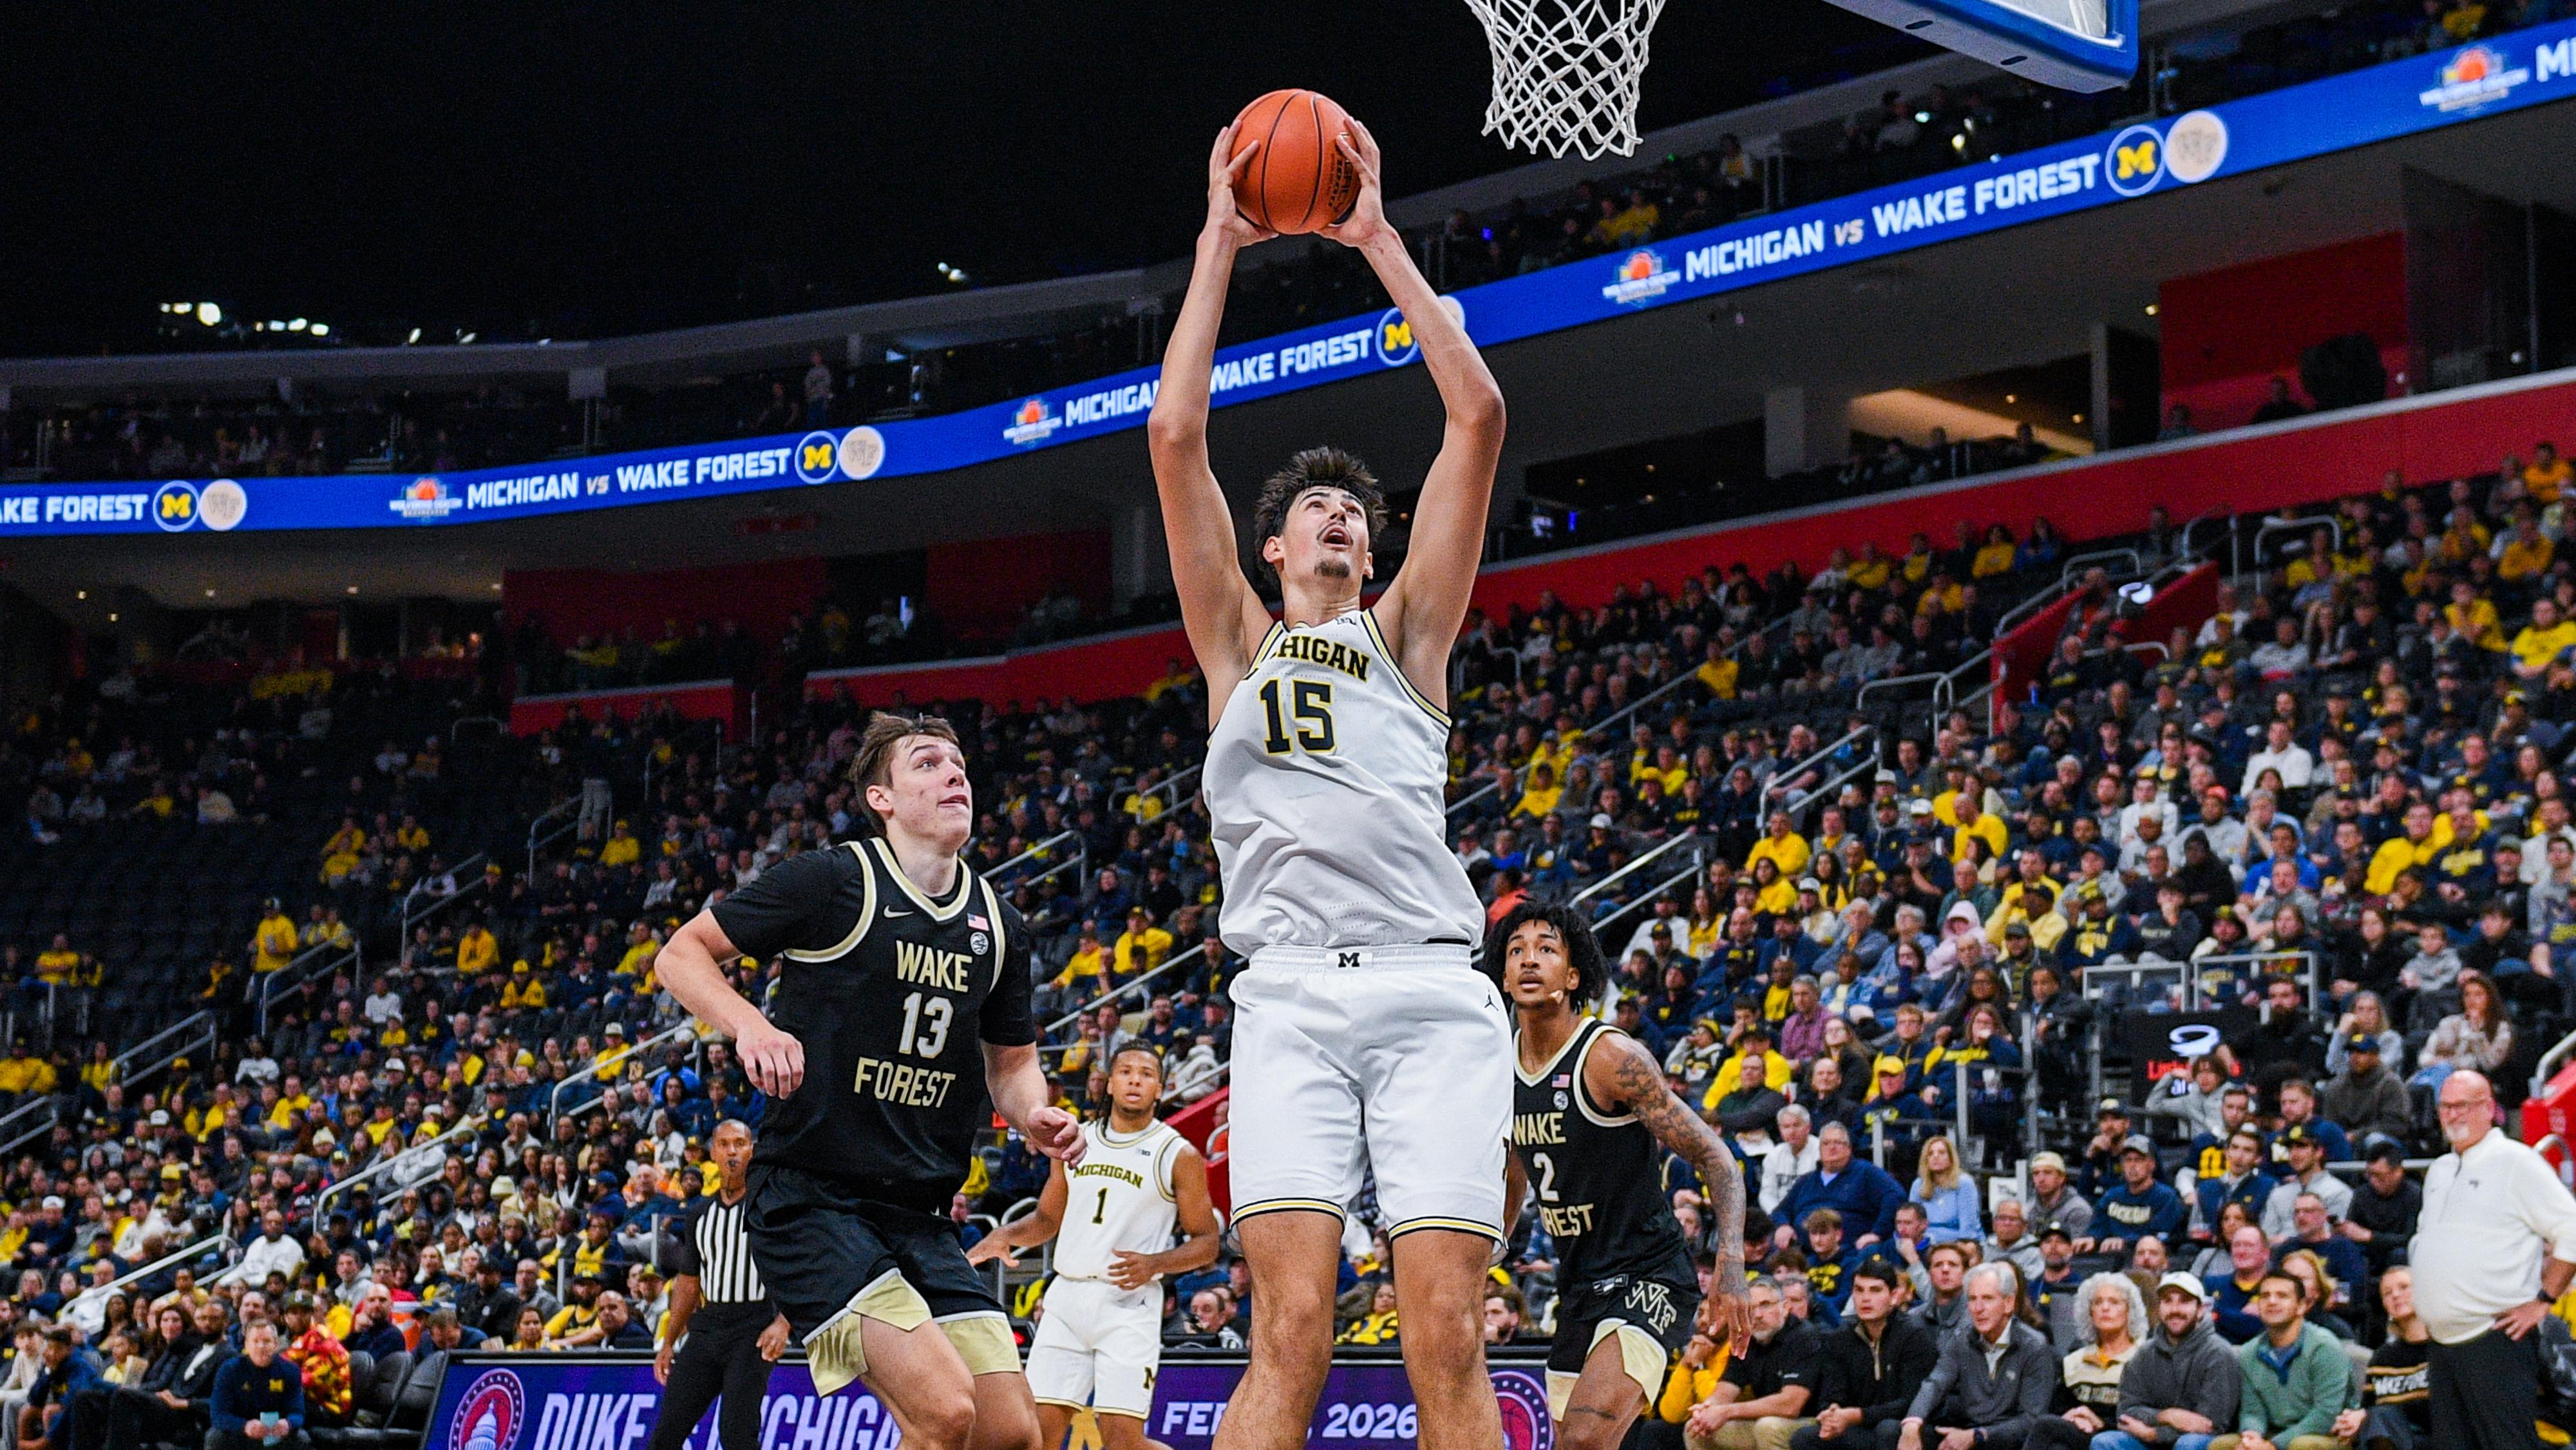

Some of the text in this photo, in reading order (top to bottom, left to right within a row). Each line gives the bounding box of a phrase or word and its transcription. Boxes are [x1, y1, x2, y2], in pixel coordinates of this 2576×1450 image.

[1686, 220, 1824, 282] MICHIGAN
[1872, 185, 1967, 238] WAKE
[1975, 153, 2101, 215] FOREST
[1210, 352, 1274, 394] WAKE
[1280, 329, 1374, 377] FOREST
[468, 472, 578, 510] MICHIGAN
[616, 459, 689, 493] WAKE
[696, 448, 791, 484] FOREST
[0, 493, 148, 523] KE FOREST
[1276, 635, 1370, 682] HIGAN
[1259, 677, 1337, 756] 15
[896, 940, 973, 993] WAKE
[1338, 952, 1360, 968] M
[898, 991, 954, 1059] 13
[854, 1056, 956, 1108] FOREST
[1513, 1112, 1566, 1145] WAKE
[1074, 1164, 1143, 1189] MICHIGAN
[1533, 1152, 1560, 1202] 2
[1092, 1187, 1108, 1225] 1
[1538, 1203, 1595, 1237] REST
[534, 1393, 656, 1450] DUKE
[1322, 1403, 1416, 1439] 2026
